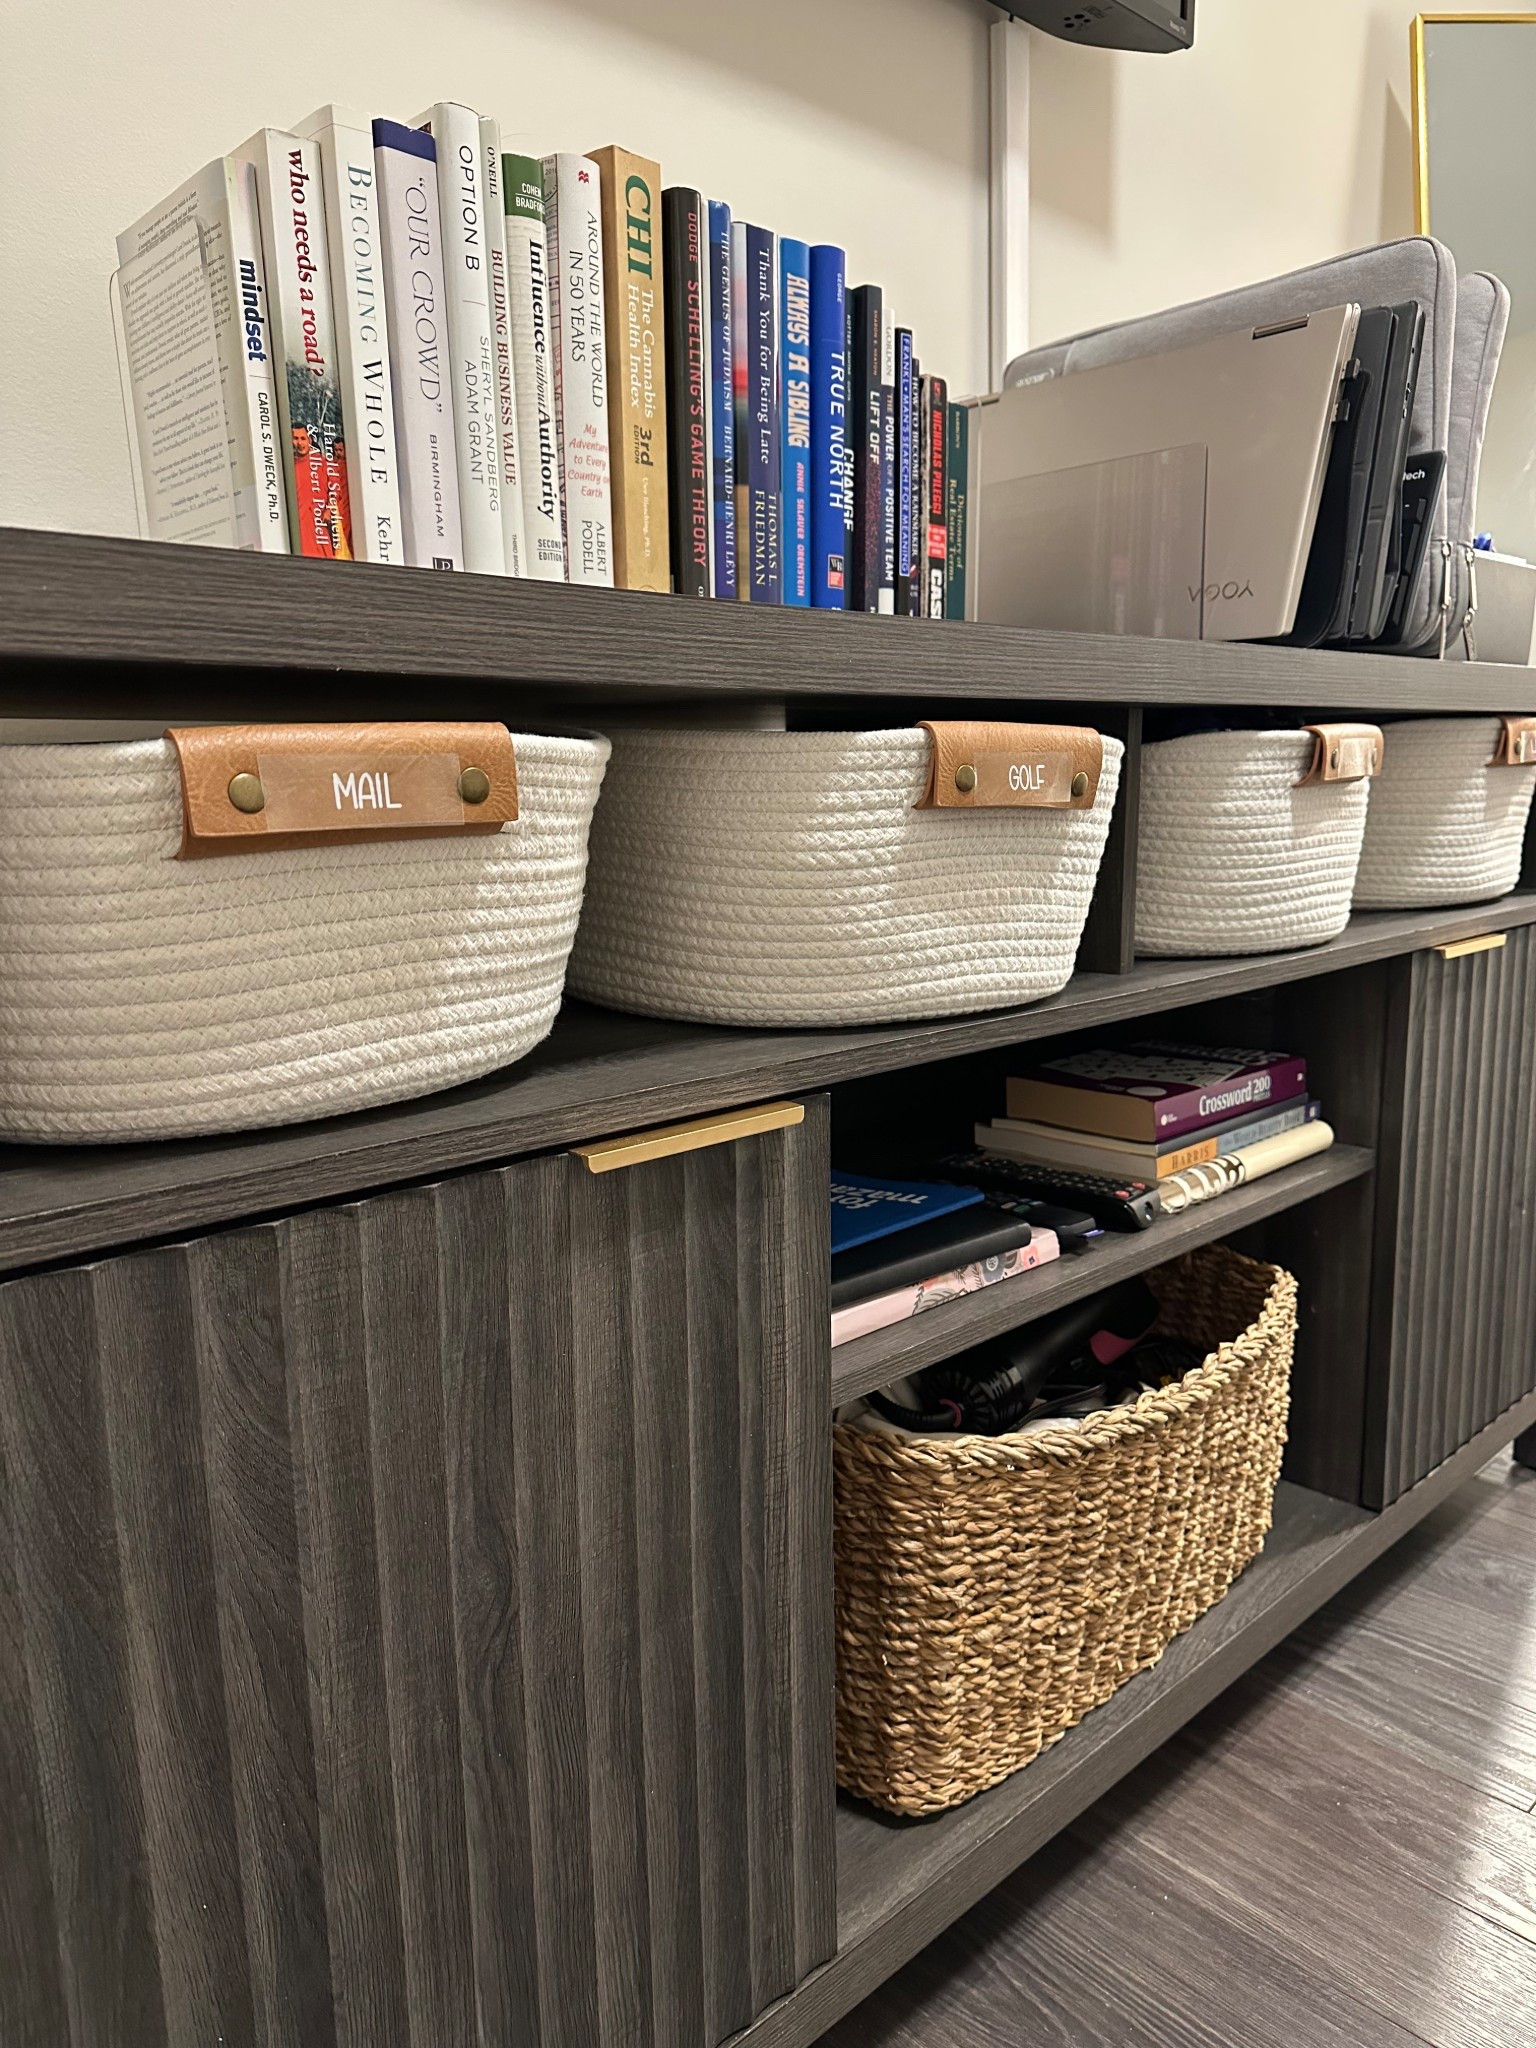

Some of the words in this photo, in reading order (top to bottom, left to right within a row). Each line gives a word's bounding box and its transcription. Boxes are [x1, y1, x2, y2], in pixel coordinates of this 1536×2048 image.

[288, 149, 310, 204] who
[459, 145, 479, 246] OPTION
[521, 182, 542, 200] COHEN
[293, 208, 317, 283] needs
[625, 175, 653, 280] CHI
[687, 212, 698, 263] DODGE
[720, 231, 730, 260] THE
[347, 162, 378, 344] BECOMING
[465, 255, 480, 271] B
[569, 250, 584, 271] IN
[587, 211, 600, 296] AROUND
[758, 247, 771, 302] Thank
[239, 259, 267, 362] mindset
[299, 287, 314, 302] a
[491, 249, 507, 335] BUILDING
[529, 239, 547, 354] Influence
[569, 275, 585, 300] 50
[641, 289, 654, 325] The
[721, 266, 731, 321] GENIUS
[786, 272, 810, 346] ALWAYS
[570, 305, 586, 362] YEARS
[590, 301, 601, 337] THE
[628, 283, 641, 348] Health
[722, 326, 732, 344] OF
[759, 309, 771, 339] You
[301, 307, 325, 377] road?
[759, 344, 772, 371] for
[788, 352, 810, 375] A
[885, 326, 893, 376] GORDON
[902, 336, 911, 383] FRANKL
[464, 360, 479, 414] ADAM
[479, 335, 493, 406] SHERYL
[497, 341, 513, 426] BUSINESS
[534, 354, 548, 408] without
[591, 342, 603, 408] WORLD
[630, 354, 642, 409] Index
[642, 330, 656, 419] Cannabis
[722, 348, 733, 412] JUDAISM
[830, 350, 845, 418] TRUE
[911, 376, 919, 404] HOW
[257, 392, 271, 433] CAROL
[362, 358, 388, 484] WHOLE
[756, 375, 771, 423] Being
[787, 379, 810, 449] SIBLING
[869, 390, 880, 428] LIFT
[886, 393, 894, 414] THE
[911, 411, 919, 428] TO
[261, 433, 272, 443] S.
[306, 423, 319, 442] &
[323, 423, 339, 478] Harold
[467, 421, 484, 485] GRANT
[583, 423, 597, 438] My
[639, 426, 654, 467] 3rd
[690, 424, 705, 481] GAME
[760, 428, 771, 465] Late
[869, 431, 880, 465] OFF
[885, 416, 895, 462] POWER
[911, 430, 919, 479] BECOME
[932, 410, 942, 468] NICHOLAS
[263, 446, 277, 491] DWECK,
[308, 444, 323, 493] Albert
[484, 413, 499, 512] SANDBERG
[502, 431, 517, 486] VALUE
[537, 408, 556, 522] Authority
[568, 469, 601, 484] Country
[574, 454, 583, 465] to
[586, 455, 607, 471] Every
[796, 461, 805, 493] ANNIE
[829, 425, 845, 509] NORTH
[886, 464, 893, 476] OF
[901, 436, 910, 483] SEARCH
[267, 493, 279, 523] Ph.D.
[429, 434, 445, 537] BIRMINGHAM
[581, 486, 603, 499] Earth
[724, 425, 735, 546] BERNARD-HENRI
[843, 447, 855, 533] CHANGE
[901, 486, 910, 511] FOR
[911, 483, 919, 492] A
[932, 470, 942, 515] PILEGGI
[949, 479, 958, 505] Real
[312, 498, 330, 546] Podell
[327, 481, 344, 550] Stephens
[377, 515, 392, 562] Kehr
[691, 487, 706, 568] THEORY
[755, 489, 766, 586] FRIEDMAN
[768, 492, 778, 569] THOMAS
[885, 488, 895, 544] POSITIVE
[911, 495, 919, 557] RAINMAKER
[949, 507, 958, 543] Estate
[956, 494, 965, 554] Dictionary
[538, 550, 562, 562] EDITION
[581, 519, 595, 575] PODELL
[595, 521, 608, 577] ALBERT
[885, 547, 894, 581] TEAM
[900, 515, 910, 575] MEANING
[947, 546, 958, 582] Terms
[957, 556, 965, 569] of
[768, 573, 778, 587] L.
[796, 543, 806, 597] ORENSTEIN
[1187, 579, 1254, 602] YOGA
[331, 771, 403, 811] MAIL
[1008, 764, 1046, 791] GOLF
[1199, 1080, 1252, 1117] Crossword
[1252, 1075, 1271, 1094] 200
[1171, 1146, 1210, 1170] HARRIS
[830, 1184, 929, 1205] maza
